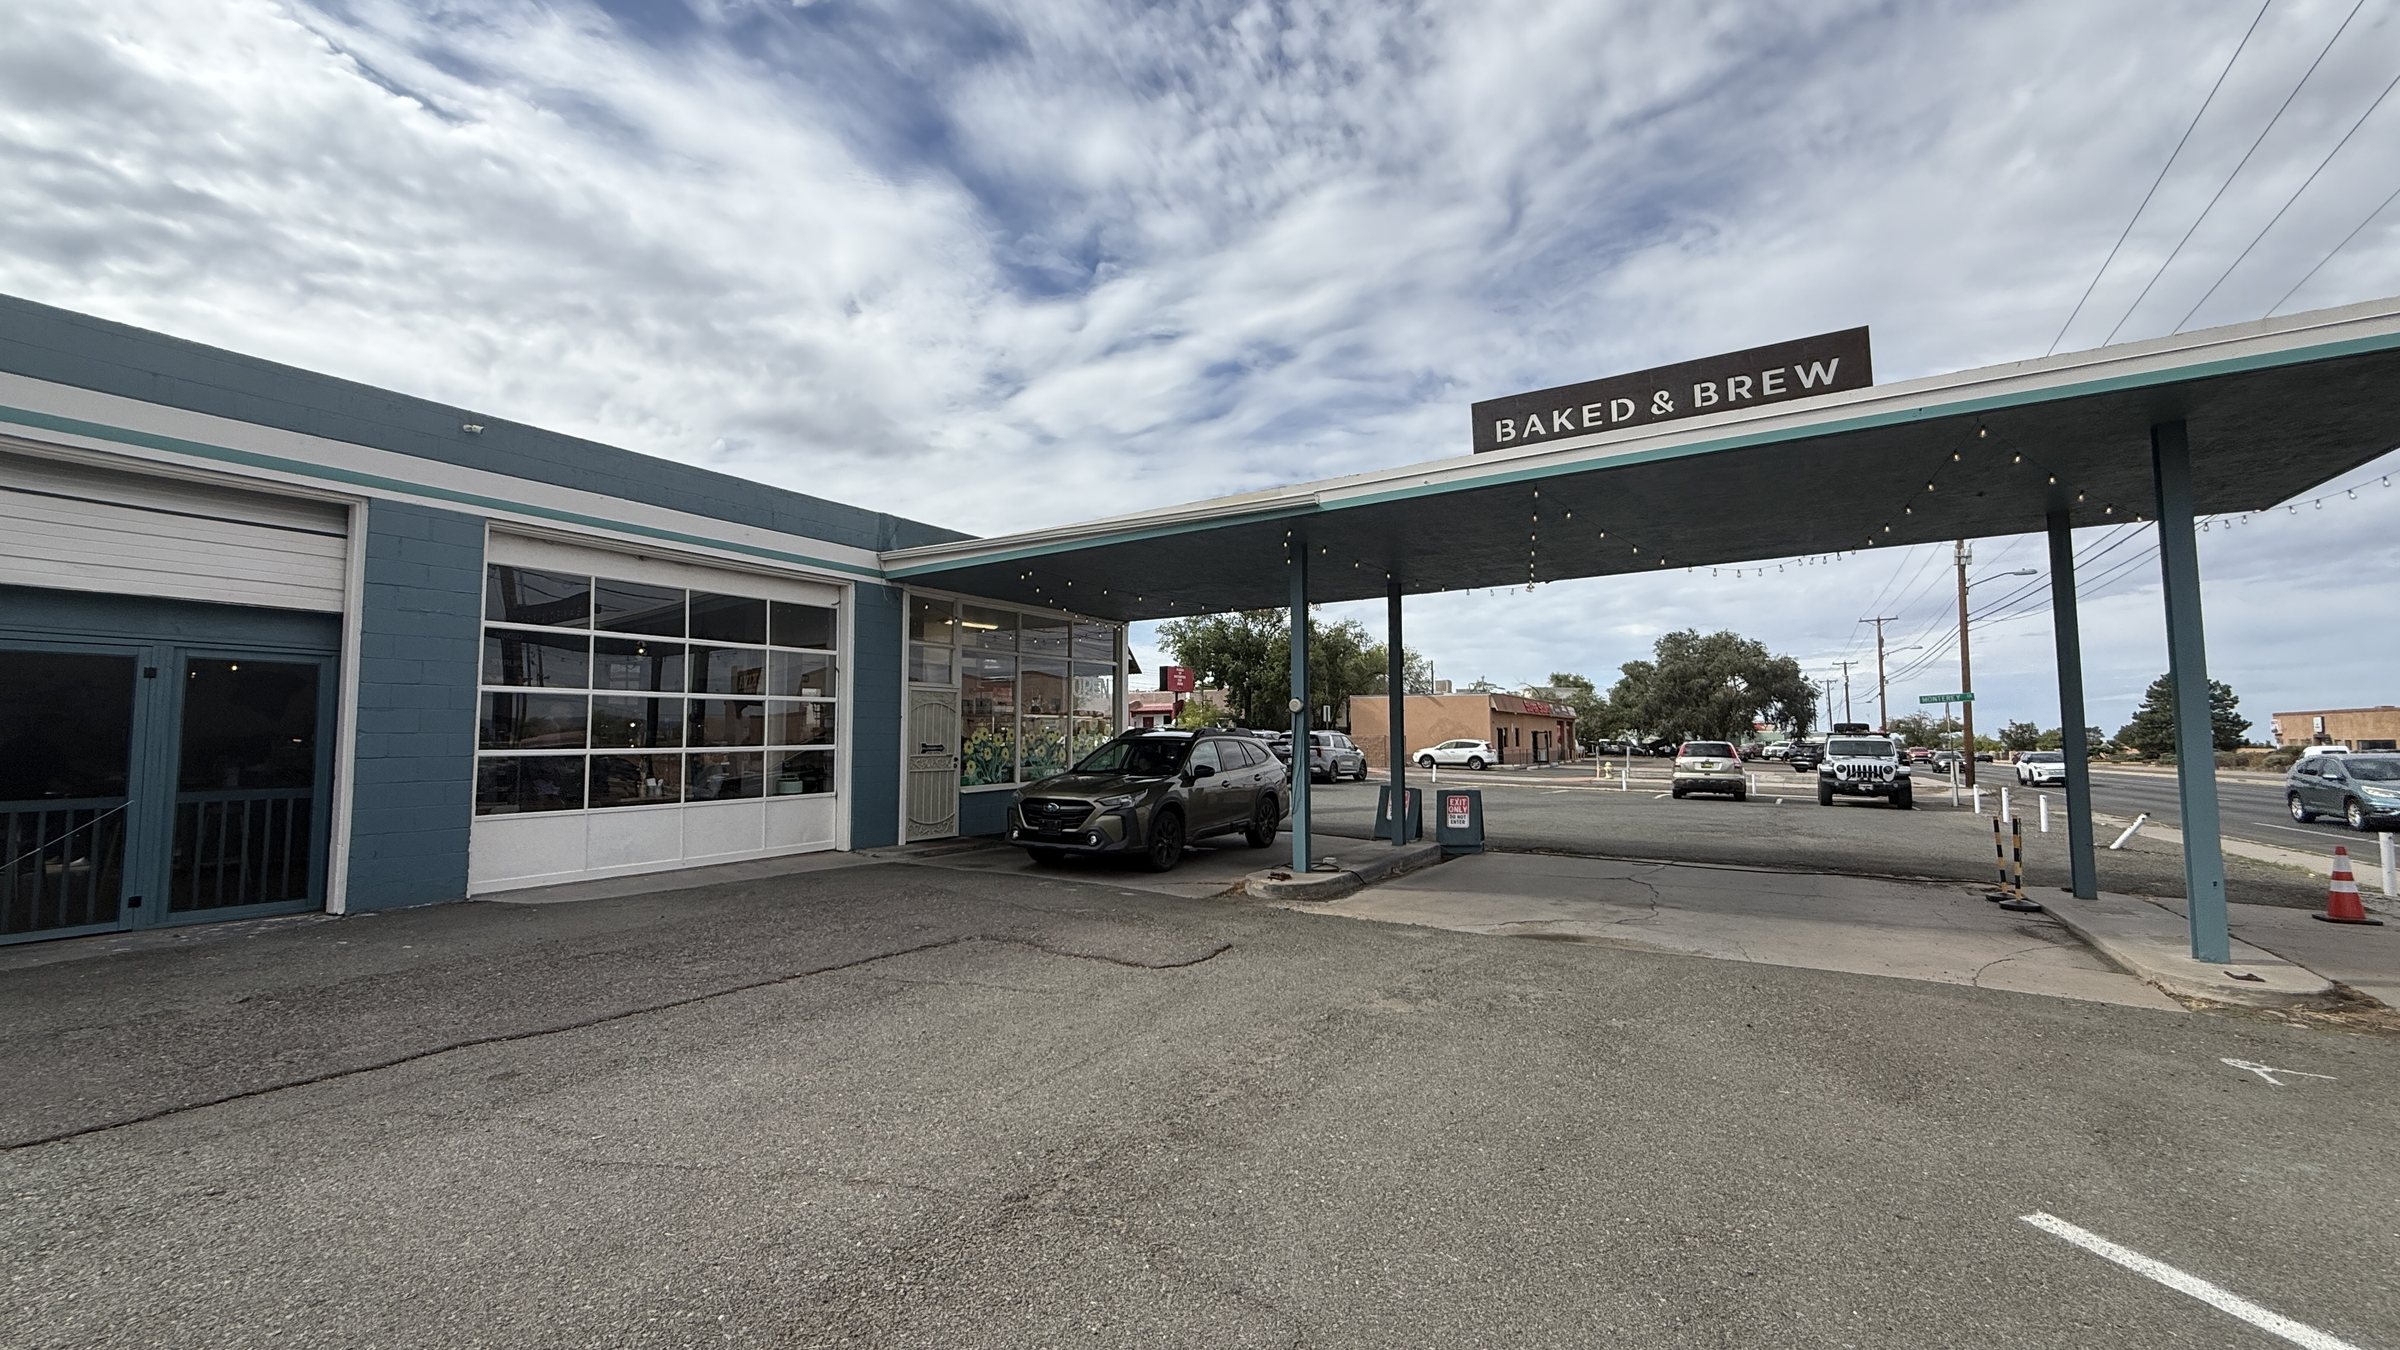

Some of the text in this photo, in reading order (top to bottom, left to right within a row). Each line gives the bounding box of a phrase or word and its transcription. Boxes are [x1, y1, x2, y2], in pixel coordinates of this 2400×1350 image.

[1495, 356, 1840, 443] BAKED & BREW
[1073, 677, 1110, 698] OPEN
[1921, 694, 1961, 702] MONTEREY
